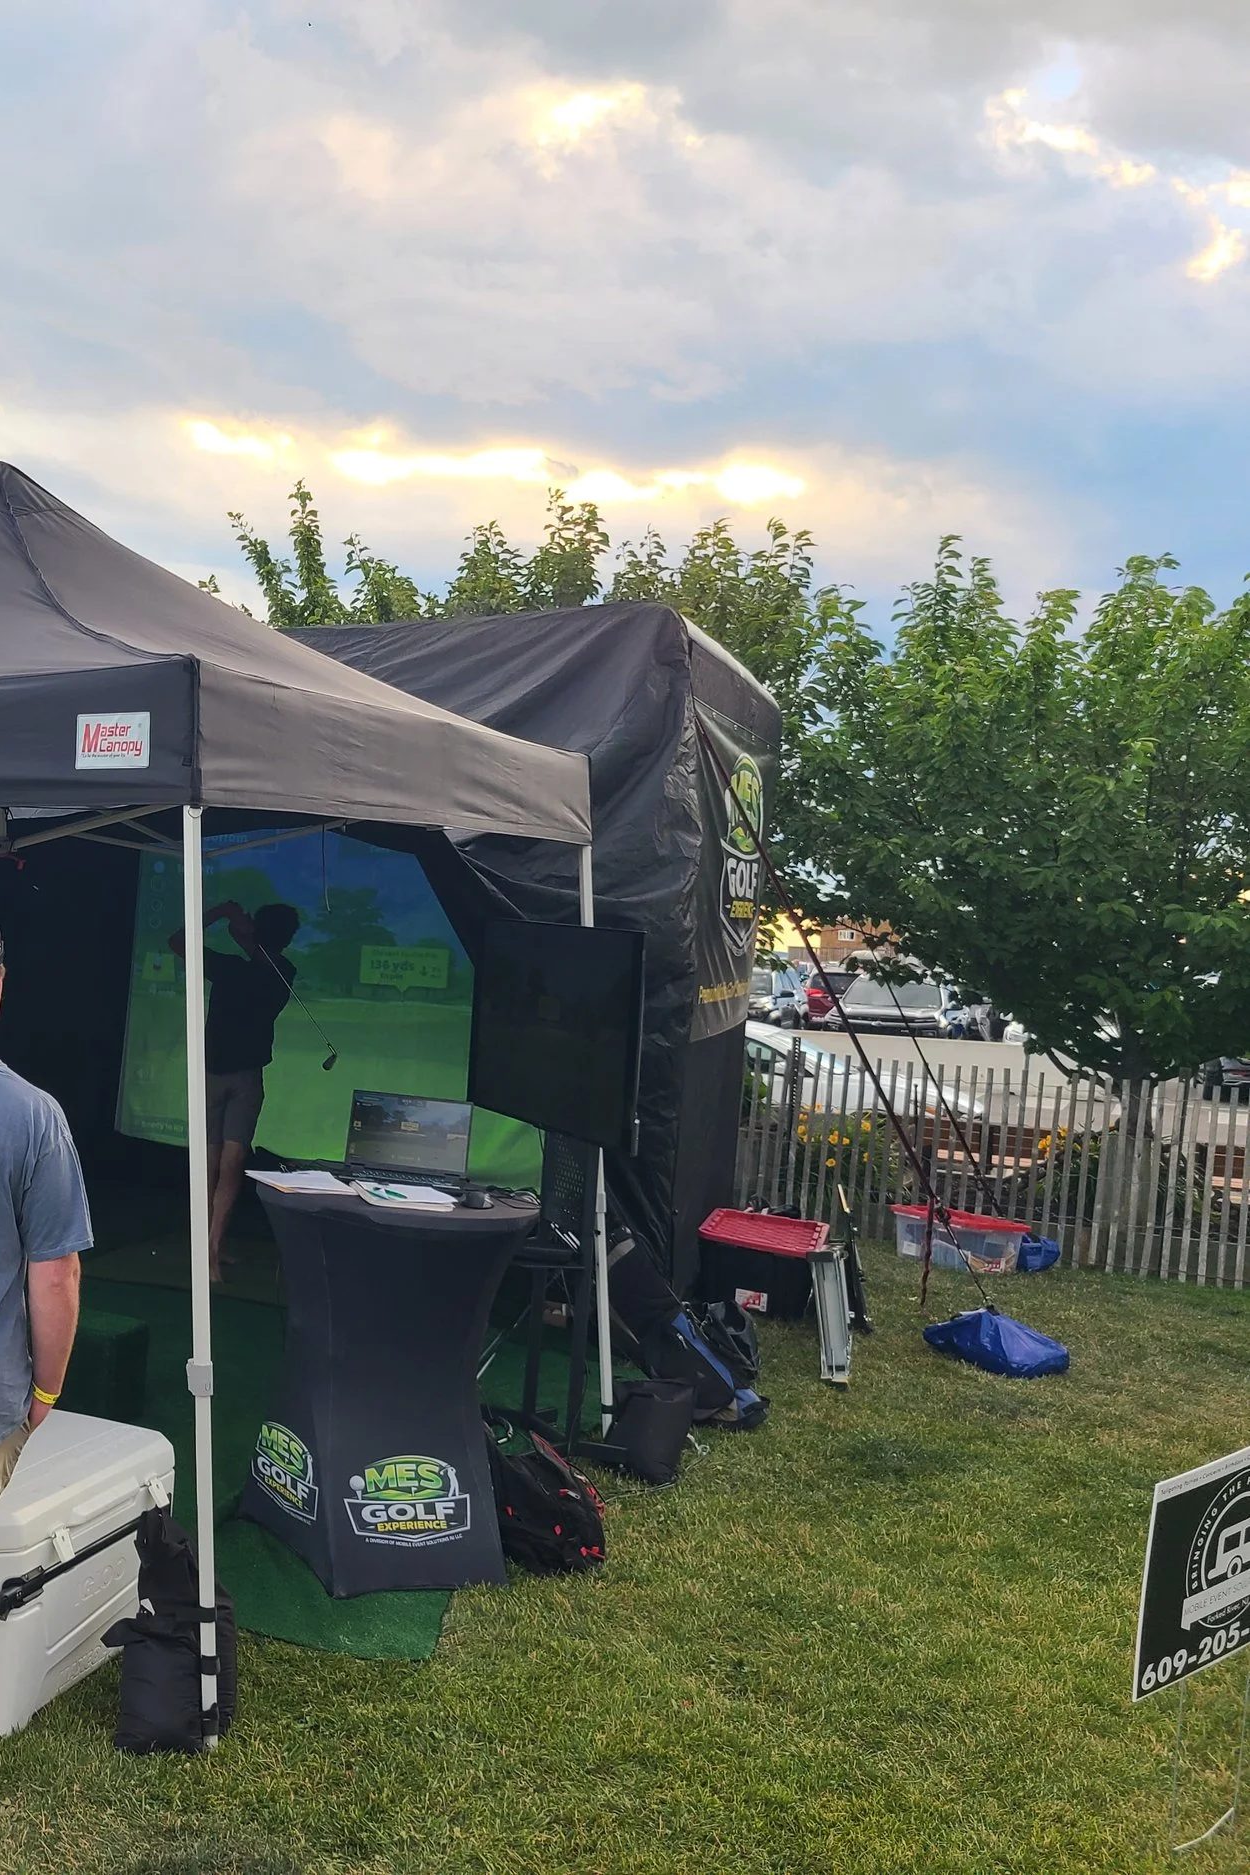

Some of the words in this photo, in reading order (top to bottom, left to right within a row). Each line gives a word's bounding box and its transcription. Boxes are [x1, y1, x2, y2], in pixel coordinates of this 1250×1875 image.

[82, 723, 131, 752] Master
[99, 738, 143, 757] Canopy
[726, 857, 758, 899] GOLF
[261, 1423, 305, 1471] MES
[256, 1456, 310, 1501] GOLF
[364, 1463, 443, 1493] MES
[1222, 1480, 1242, 1502] THE
[263, 1476, 304, 1511] EXPERIENCE
[361, 1501, 456, 1523] GOLF
[376, 1520, 448, 1533] EXPERIENCE
